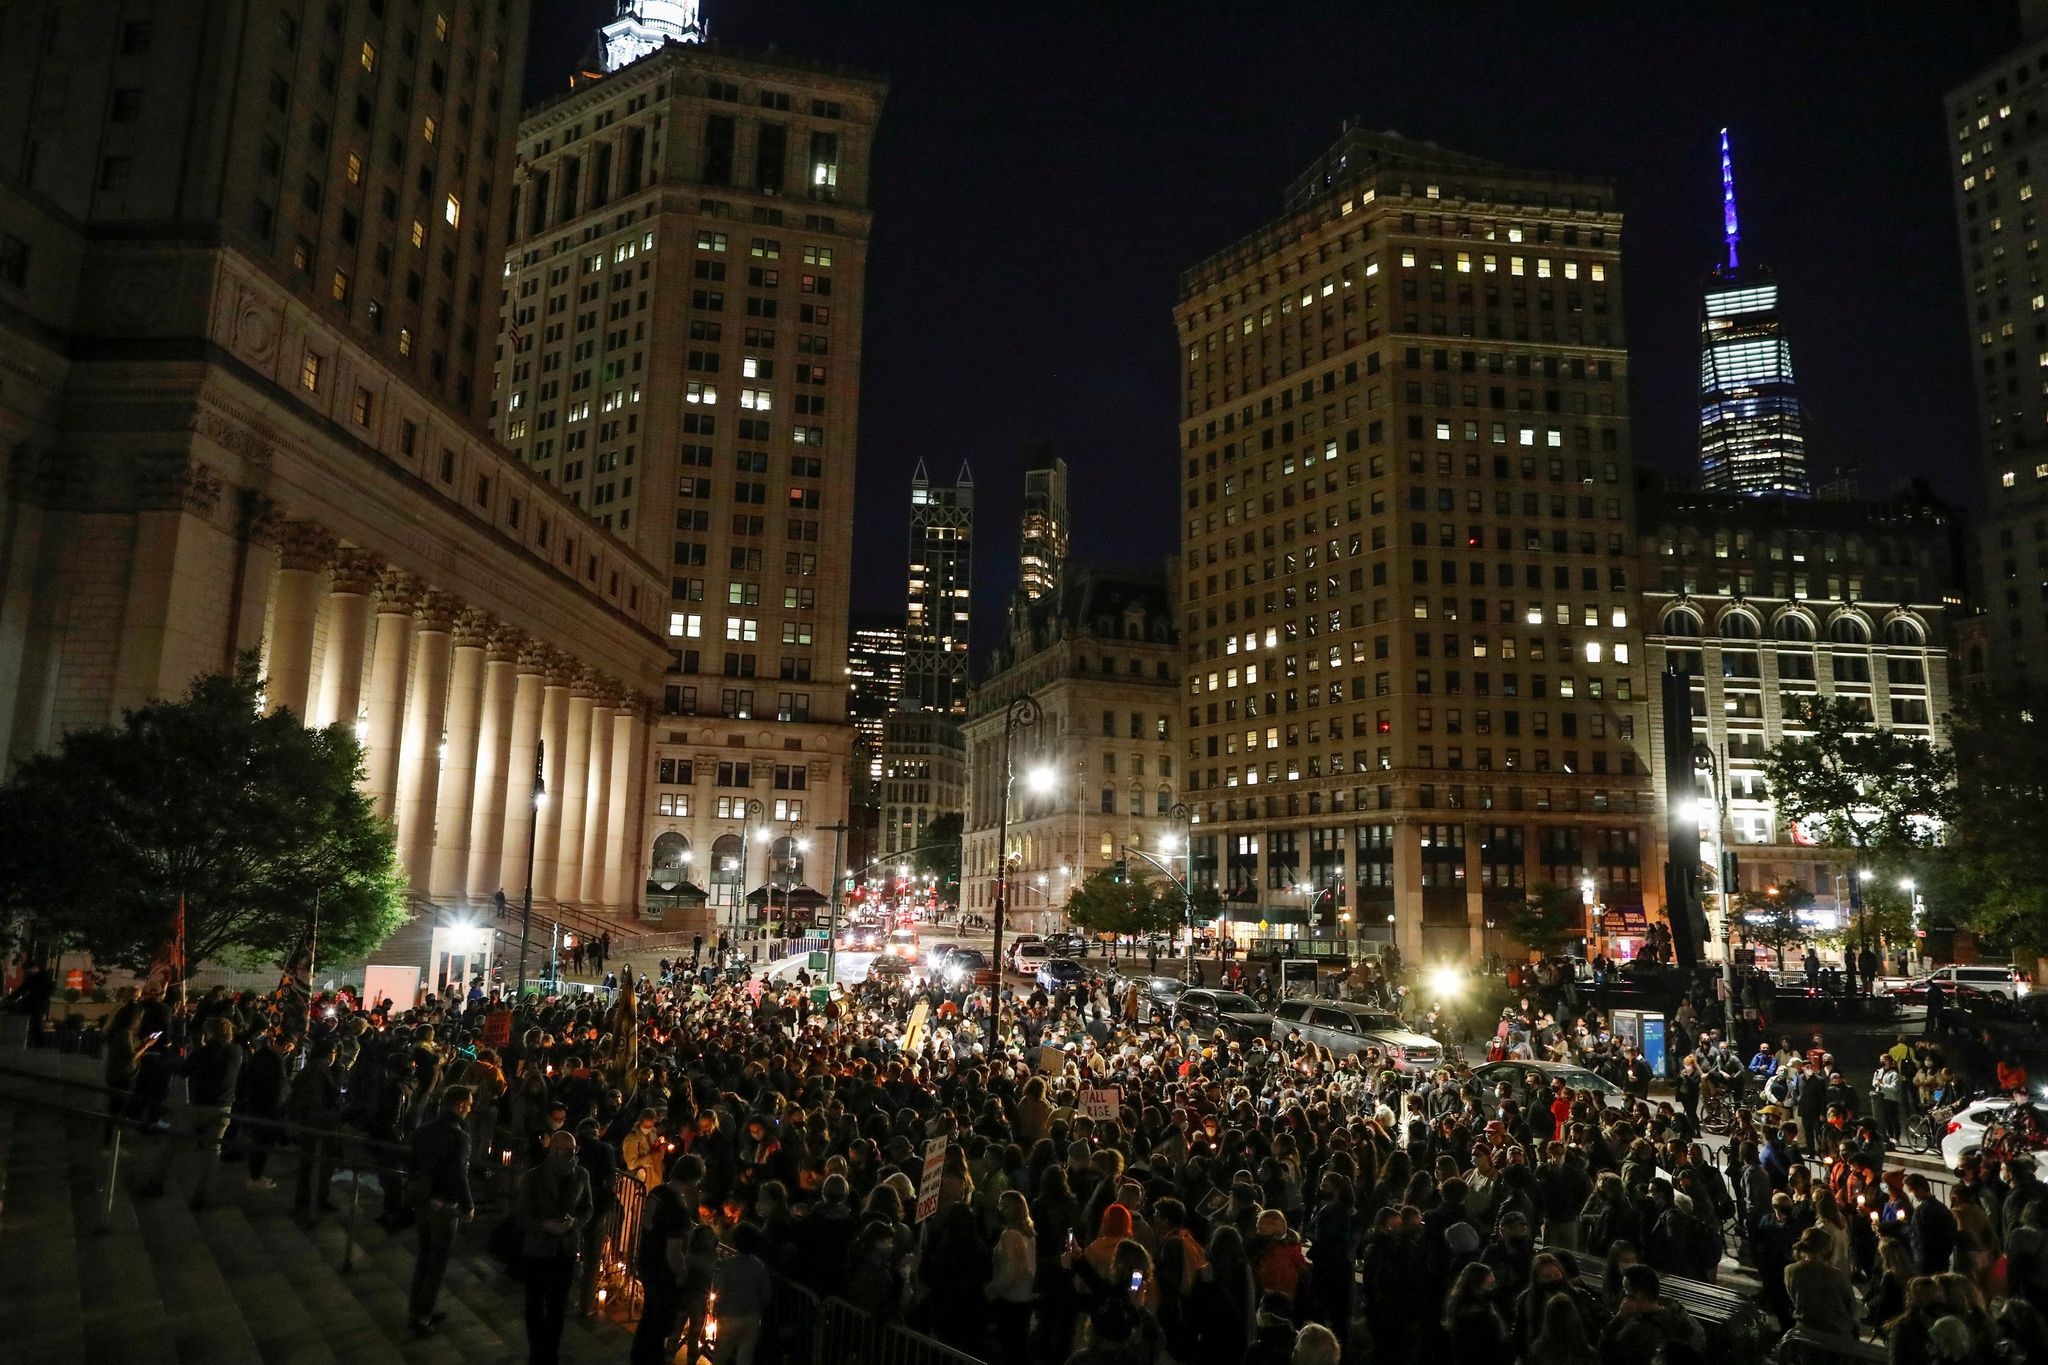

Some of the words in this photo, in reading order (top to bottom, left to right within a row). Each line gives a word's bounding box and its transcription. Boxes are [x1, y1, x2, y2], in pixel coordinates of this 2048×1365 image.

[1089, 1091, 1106, 1103] ALL
[1087, 1105, 1111, 1117] RISE
[917, 1194, 938, 1219] ROBES
